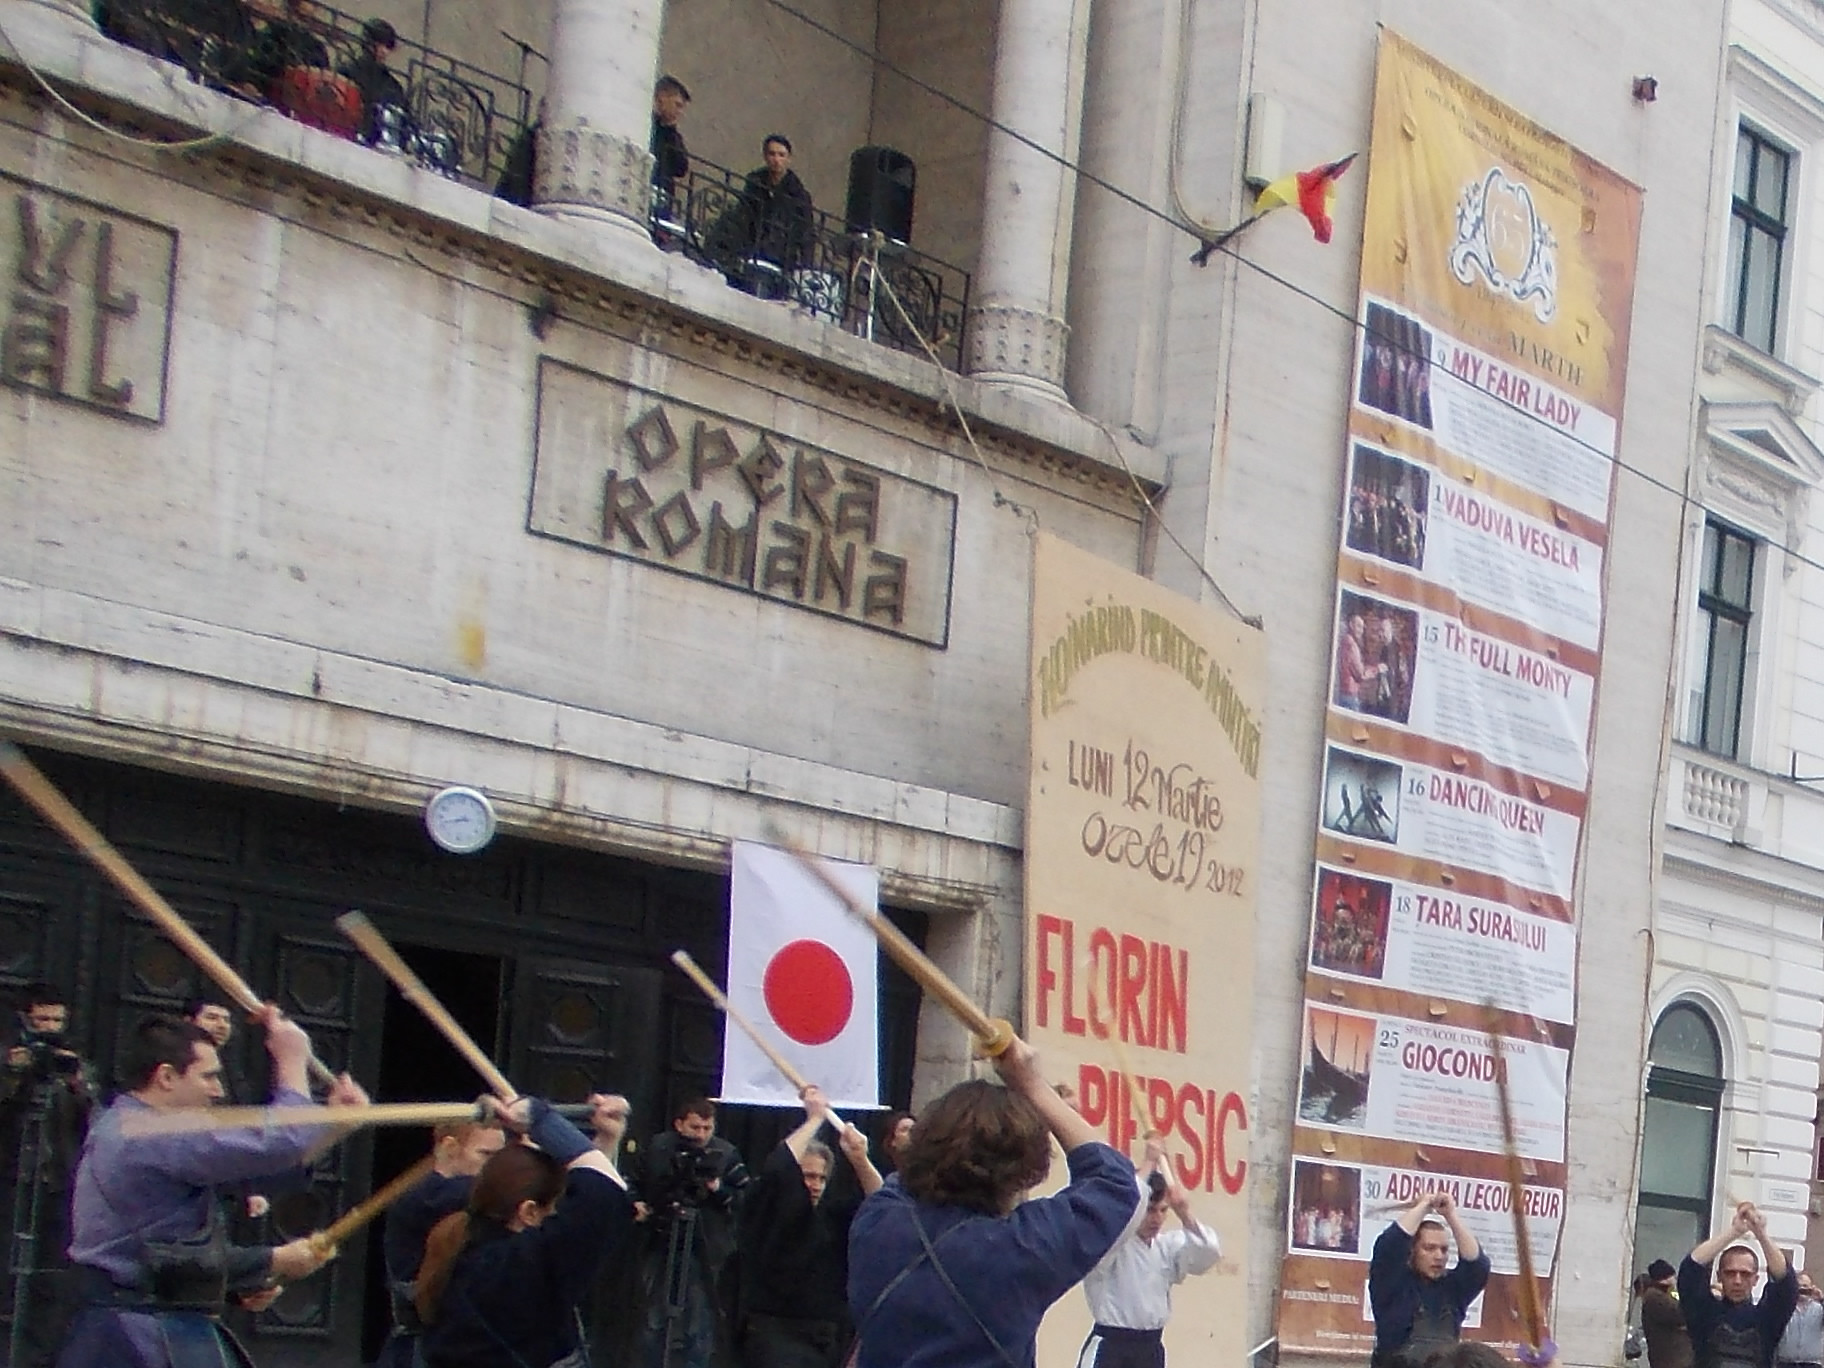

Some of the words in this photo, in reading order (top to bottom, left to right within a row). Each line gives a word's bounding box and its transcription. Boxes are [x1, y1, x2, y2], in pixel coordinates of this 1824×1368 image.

[1453, 347, 1483, 386] MY
[1486, 364, 1531, 409] FAIR
[1534, 388, 1581, 431] LADY
[627, 403, 881, 544] OPERA
[601, 469, 908, 626] ROMANA
[1444, 487, 1514, 545] VADUVA
[1518, 521, 1580, 573] VESELA
[1423, 625, 1438, 643] 15
[1470, 636, 1511, 676] FULL
[1516, 655, 1572, 698] MONTY
[1068, 739, 1113, 798] LUNI
[1123, 737, 1151, 812] 12
[1150, 763, 1225, 832] Martie
[1408, 778, 1425, 796] 16
[1172, 829, 1206, 892] 19
[1206, 859, 1246, 897] 2012
[1396, 896, 1411, 913] 18
[1036, 914, 1189, 1054] FLORIN
[1379, 1029, 1399, 1048] 25
[1402, 1041, 1508, 1085] GIOCONDA
[1365, 1180, 1381, 1199] 30
[1463, 1182, 1560, 1219] LECOUREUR
